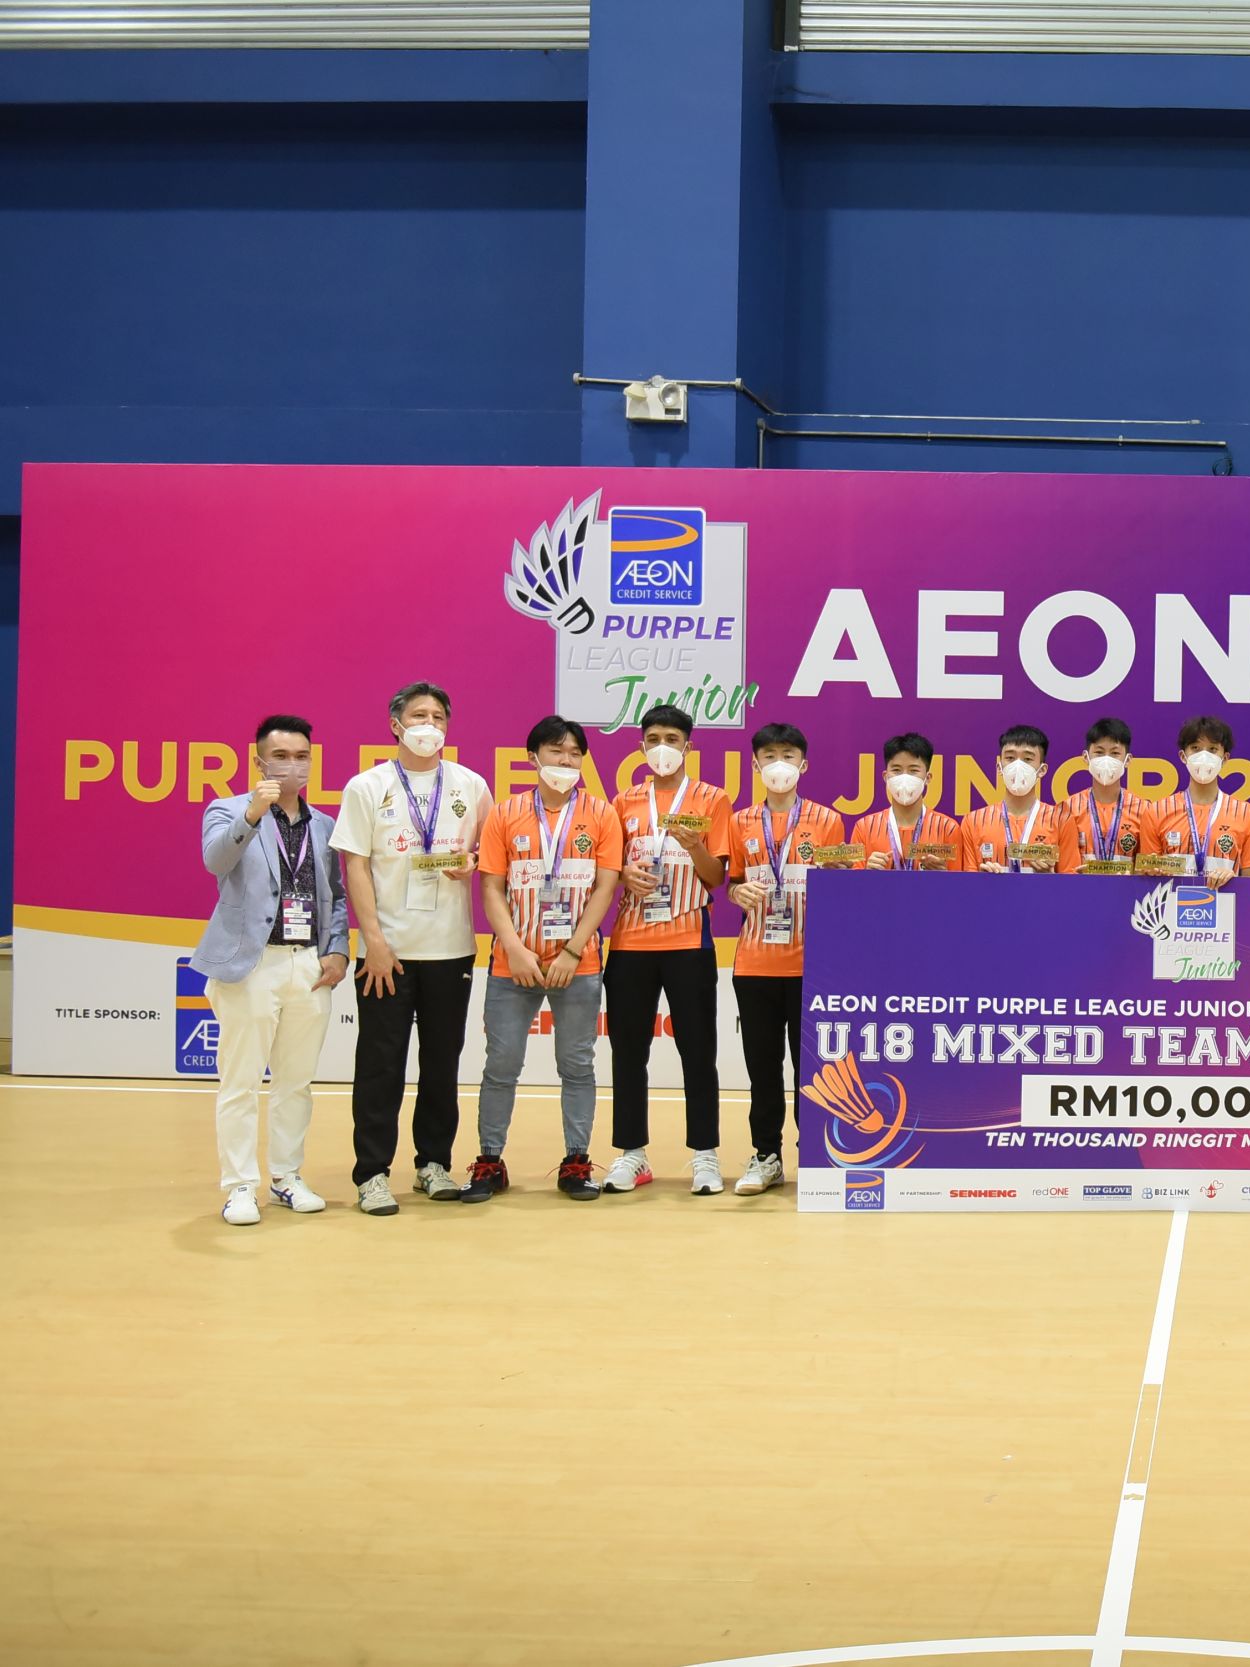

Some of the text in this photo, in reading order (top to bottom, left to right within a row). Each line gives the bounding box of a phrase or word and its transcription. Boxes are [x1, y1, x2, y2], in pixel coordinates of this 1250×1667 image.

[616, 589, 693, 599] CREDIT SERVICE
[602, 615, 735, 640] PURPLE
[567, 646, 697, 672] LEAGUE
[418, 860, 462, 869] CHAMPION
[1173, 931, 1230, 943] PURPLE
[1158, 945, 1217, 957] LEAGUE
[1172, 957, 1241, 983] Junior
[809, 995, 877, 1013] AEON
[885, 995, 969, 1014] CREDIT
[977, 997, 1067, 1016] PURPLE
[1074, 998, 1167, 1017] LEAGUE
[56, 1008, 161, 1020] TITLE SPONSOR:
[341, 1015, 354, 1024] IN
[932, 1024, 1104, 1065] MIXED
[985, 1131, 1026, 1147] TEN
[1032, 1132, 1147, 1148] THOUSAND
[1152, 1132, 1243, 1148] RINGGIT
[949, 1189, 1017, 1198] SENHENG
[1154, 1188, 1190, 1196] BIZ LINK
